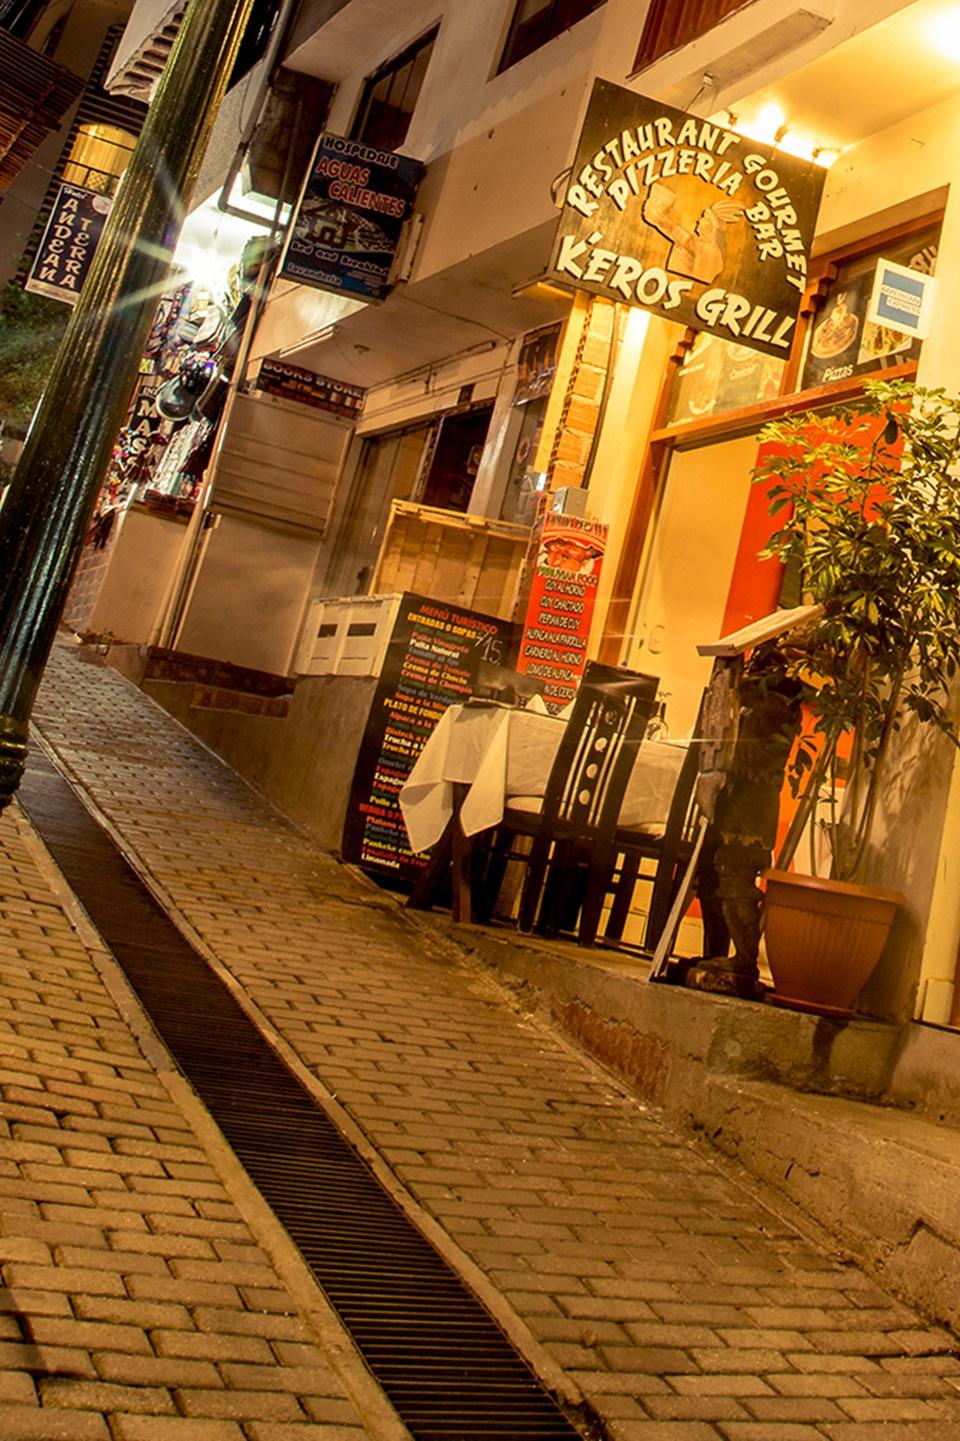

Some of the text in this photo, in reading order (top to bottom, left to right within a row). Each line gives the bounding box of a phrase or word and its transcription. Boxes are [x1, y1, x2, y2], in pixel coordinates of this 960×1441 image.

[324, 136, 399, 169] HOSPEDAJE
[316, 156, 370, 187] AGUAS
[567, 117, 741, 217] RESTAURANT
[607, 148, 743, 211] PIZZERIA
[328, 181, 406, 218] CALIENTES
[743, 153, 808, 295] GOURMET
[744, 201, 784, 261] BAR
[59, 217, 93, 289] TERRA
[696, 288, 796, 348] GRILL
[822, 364, 854, 383] Pizzas
[407, 613, 444, 628] ENTRADAS
[409, 639, 459, 658] Palta Natural
[401, 669, 426, 681] Crema
[403, 662, 428, 673] Crema
[429, 668, 440, 676] de
[383, 698, 407, 710] PLATO
[408, 705, 418, 713] DE
[382, 742, 409, 754] Trucha
[384, 735, 411, 746] Trucha
[360, 854, 400, 868] Limonada
